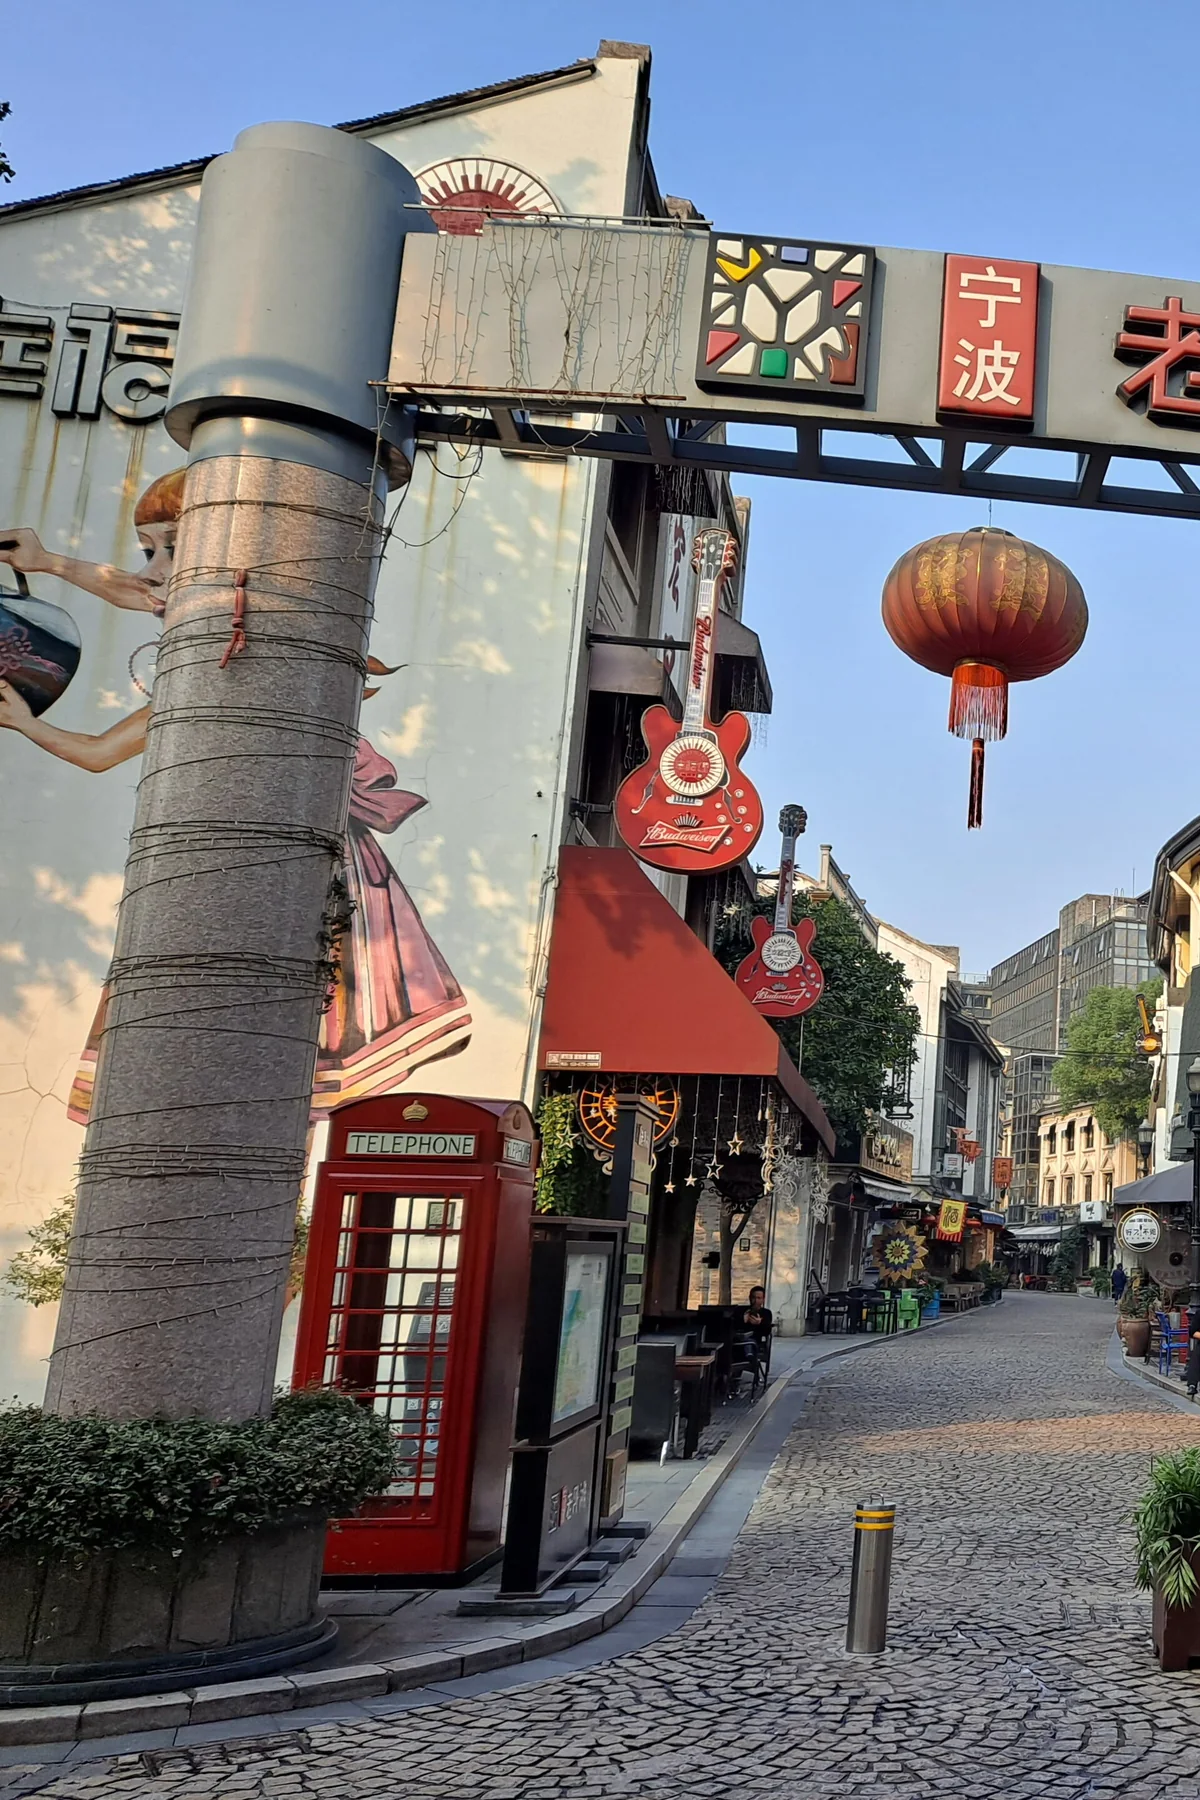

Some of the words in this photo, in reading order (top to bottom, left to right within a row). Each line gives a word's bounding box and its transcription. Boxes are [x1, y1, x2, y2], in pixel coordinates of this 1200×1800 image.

[951, 265, 1022, 406] 宁波
[691, 615, 712, 690] Budweiser
[647, 825, 721, 844] Budweiser
[756, 989, 802, 1002] Budweiser
[350, 1134, 474, 1155] TELEPHONE
